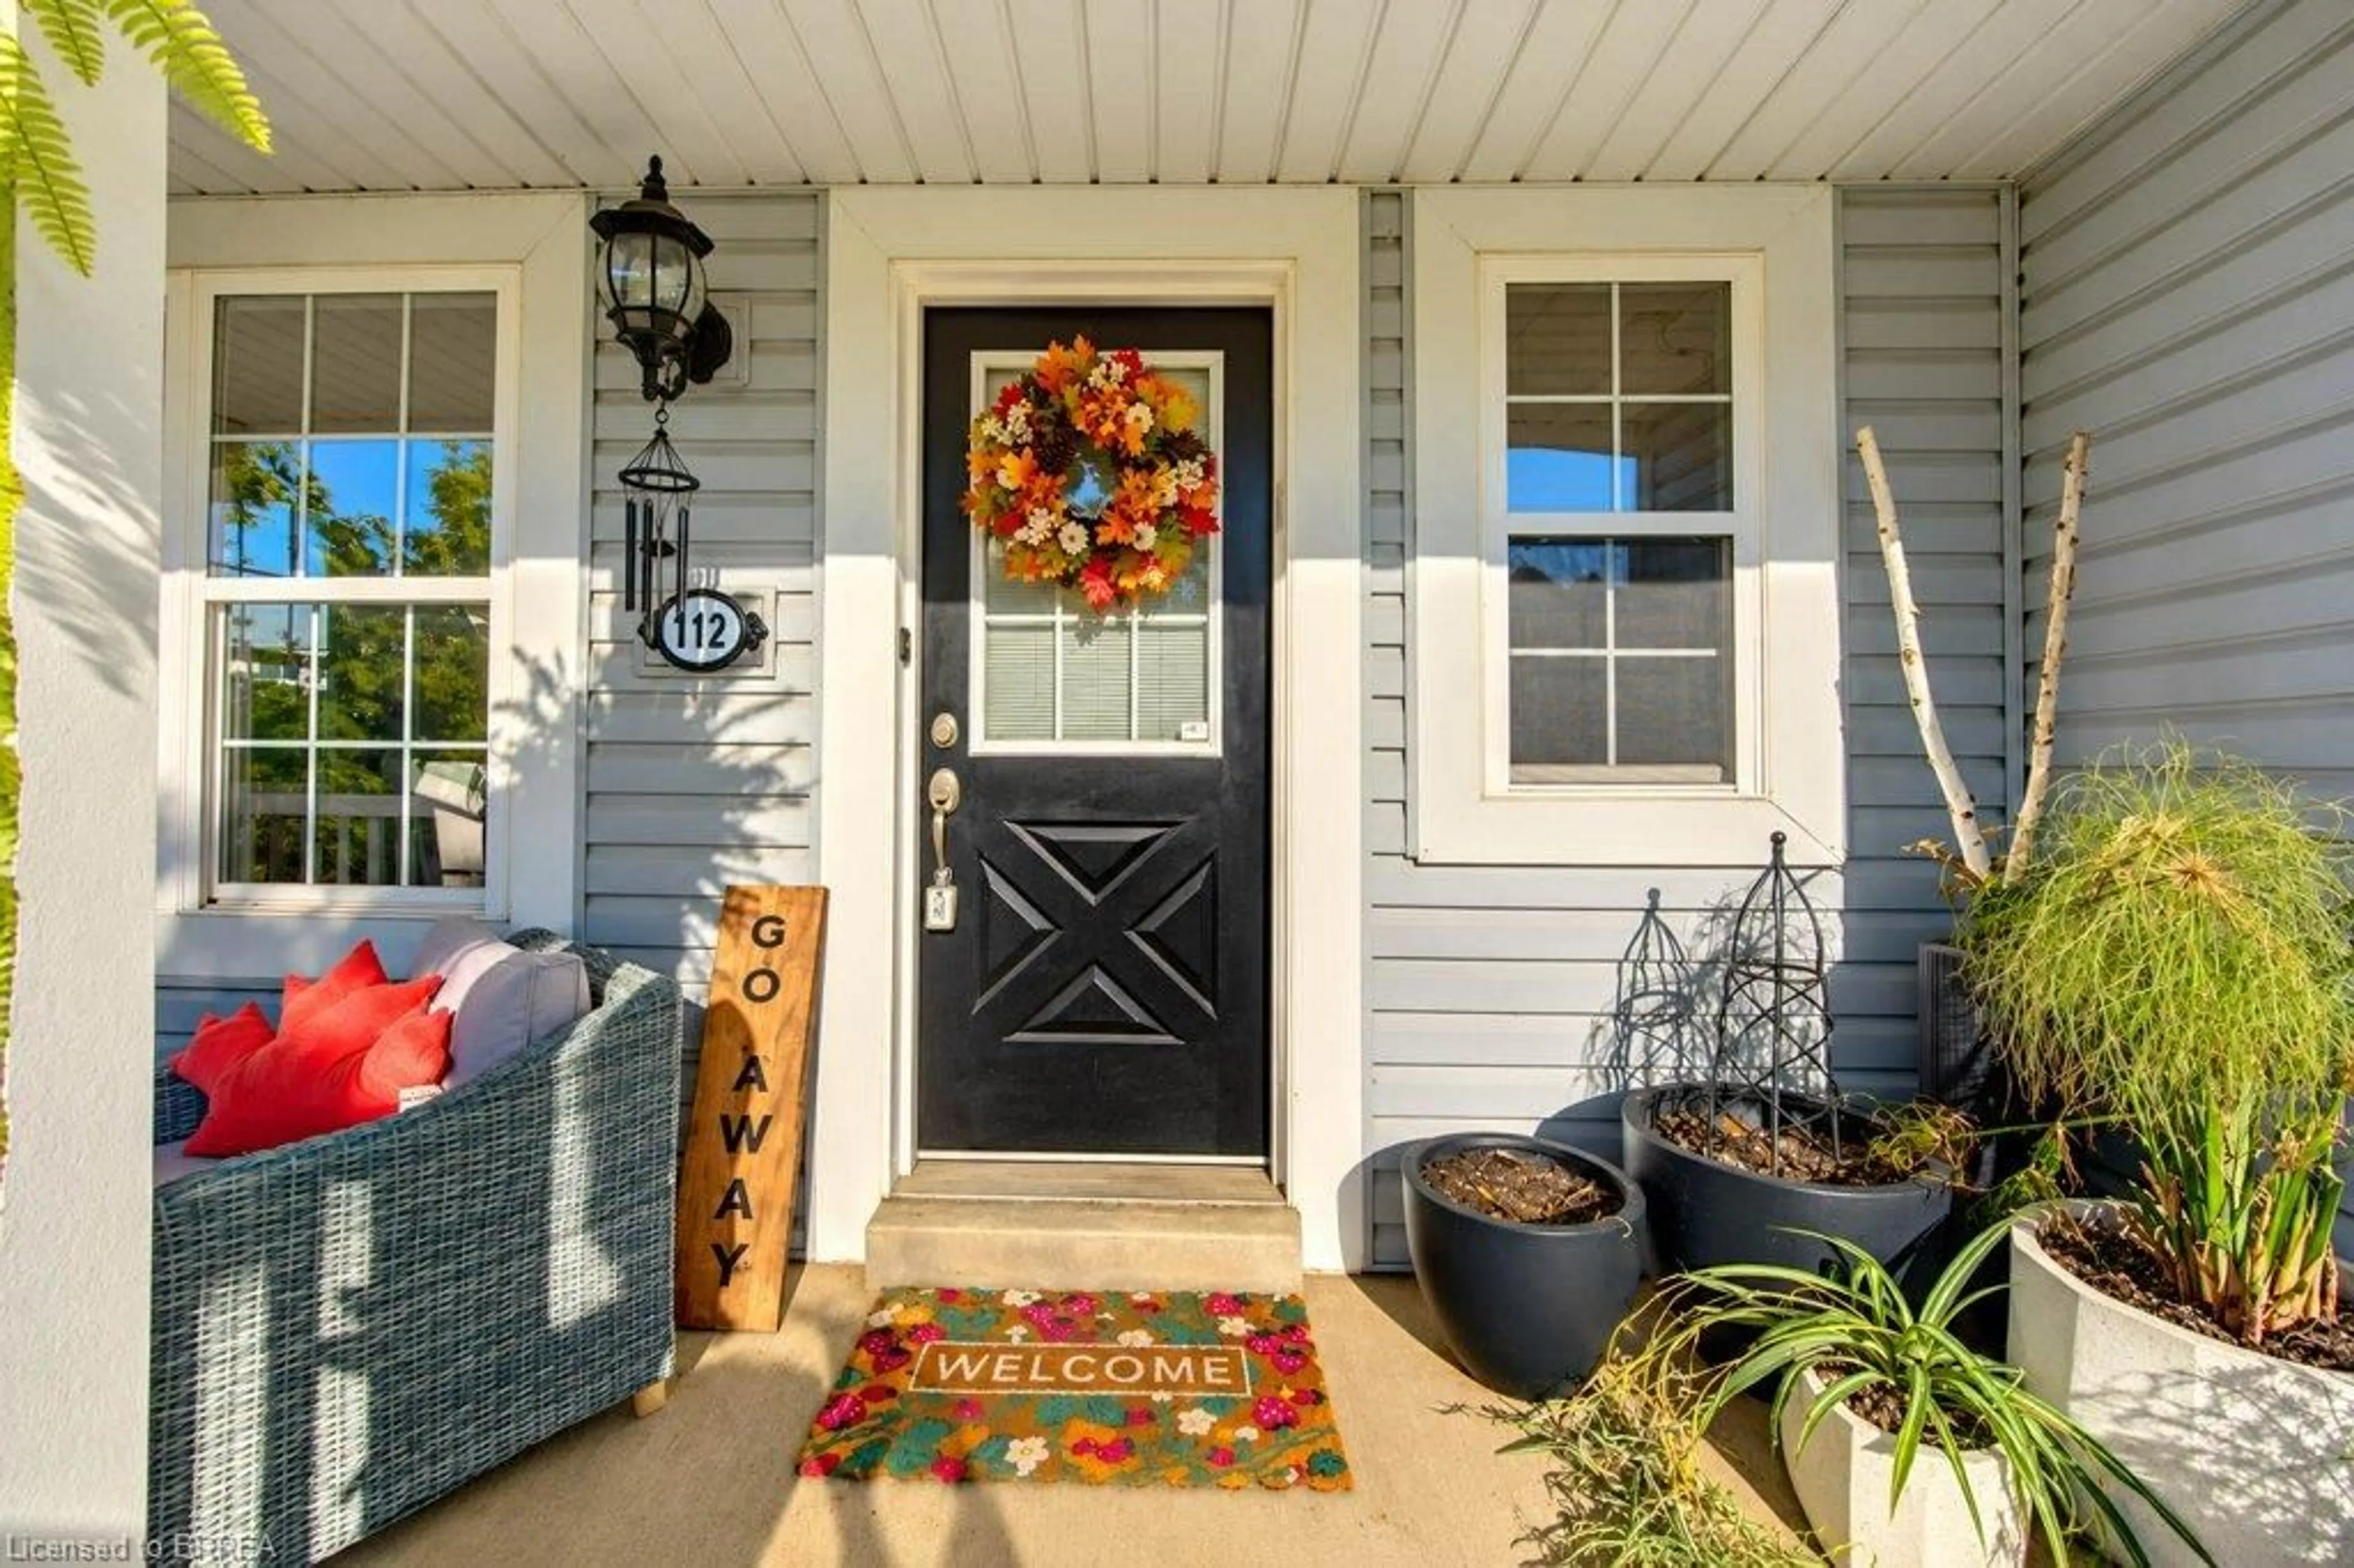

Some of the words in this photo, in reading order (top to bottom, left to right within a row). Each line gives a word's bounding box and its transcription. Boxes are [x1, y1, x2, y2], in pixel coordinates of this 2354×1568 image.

[674, 611, 725, 649] 112
[742, 915, 785, 1003] GO
[710, 1055, 772, 1287] AWAY
[936, 1353, 1232, 1385] WELCOME
